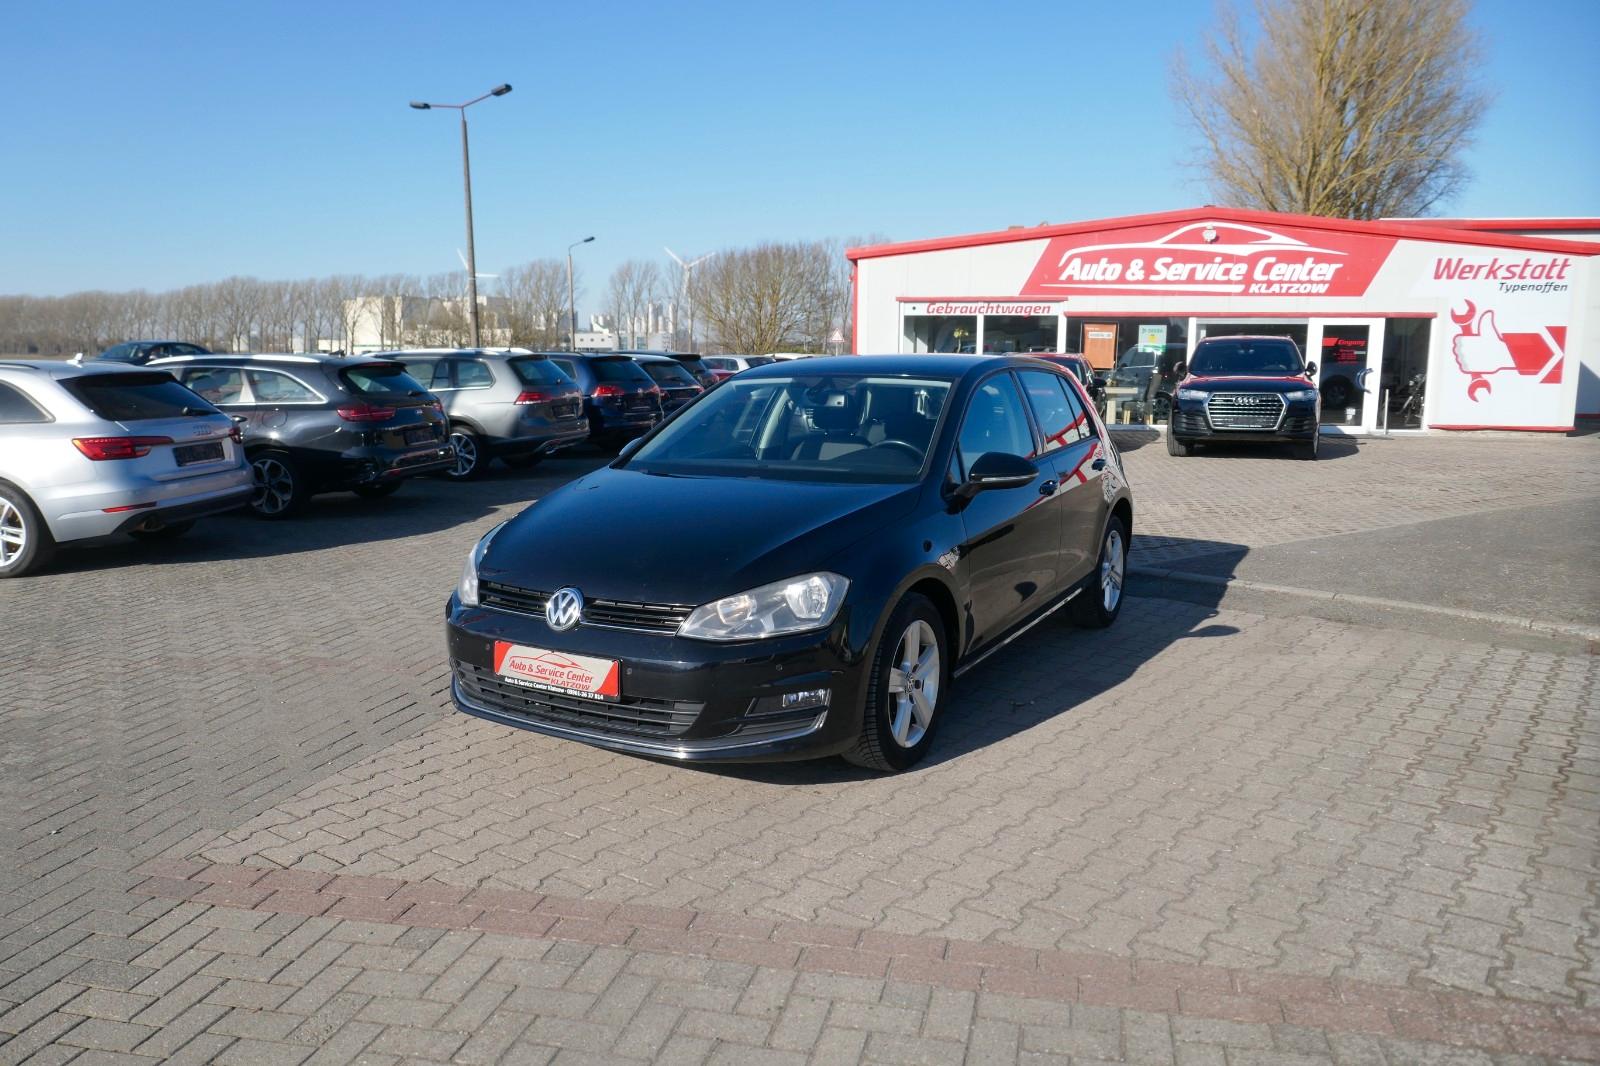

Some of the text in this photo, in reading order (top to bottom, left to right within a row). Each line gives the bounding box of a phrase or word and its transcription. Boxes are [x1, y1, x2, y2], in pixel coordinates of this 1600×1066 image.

[1059, 256, 1343, 282] Auto & Service Center
[1433, 257, 1572, 281] Werkstatt
[1248, 283, 1330, 294] KLATZOW
[1499, 282, 1568, 294] Typenoffen
[926, 302, 1051, 318] Gebrauchtwagen
[509, 660, 594, 684] Auto & Service Center
[550, 678, 591, 691] KLATZOW
